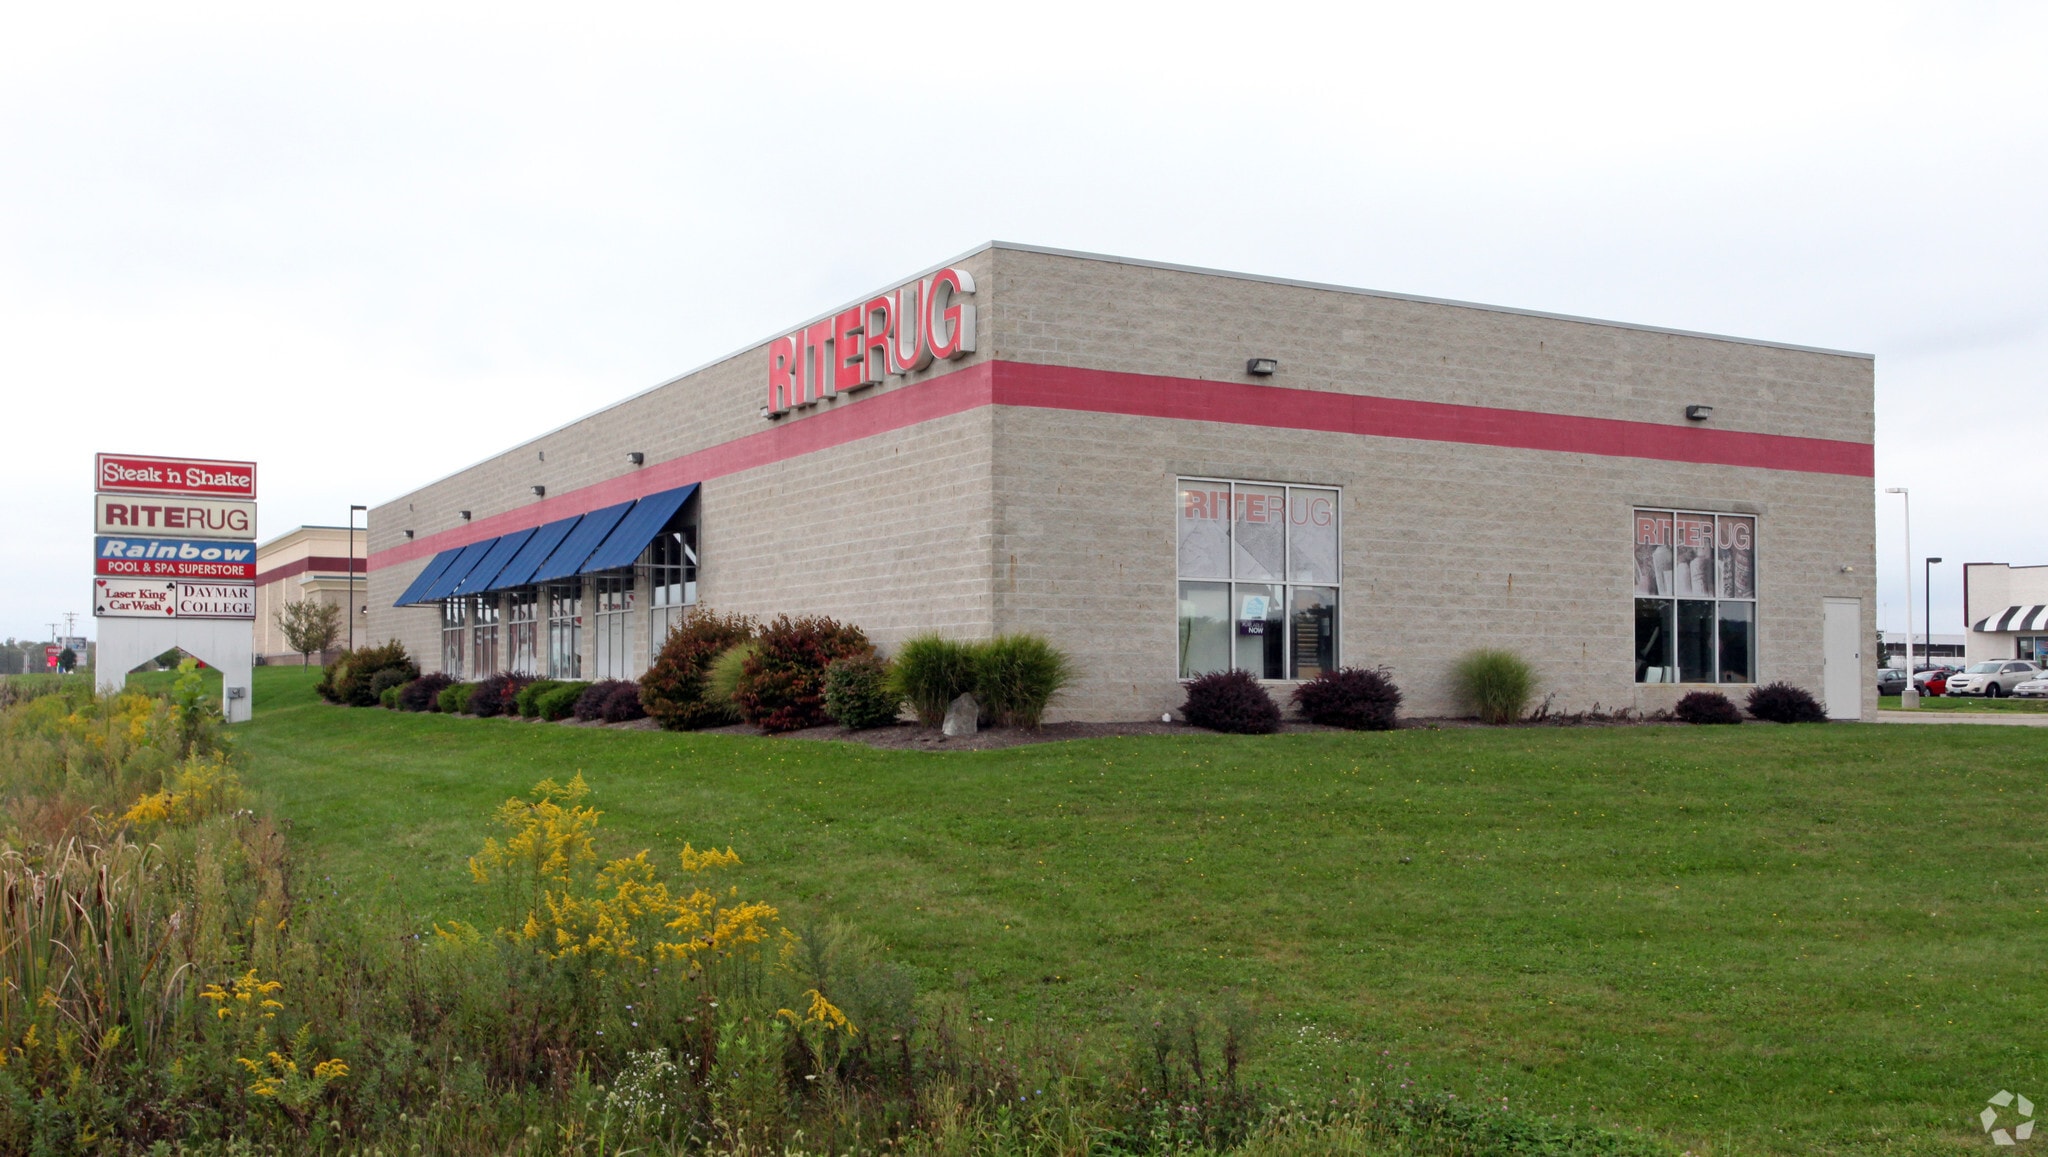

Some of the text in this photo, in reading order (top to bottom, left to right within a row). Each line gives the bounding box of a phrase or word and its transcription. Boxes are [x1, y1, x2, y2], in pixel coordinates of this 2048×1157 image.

[767, 267, 975, 415] RITERUG
[103, 462, 162, 483] Steak
[186, 467, 250, 488] Shake
[105, 503, 249, 531] RITERUG
[1184, 489, 1332, 527] RITERUG
[1637, 517, 1750, 550] RITERUG
[102, 540, 250, 562] Rainbow
[108, 561, 245, 575] POOL & SPA SUPERSTORE
[105, 588, 167, 602] Laser King
[184, 585, 248, 598] DAYMAR
[180, 600, 252, 614] COLLEGE
